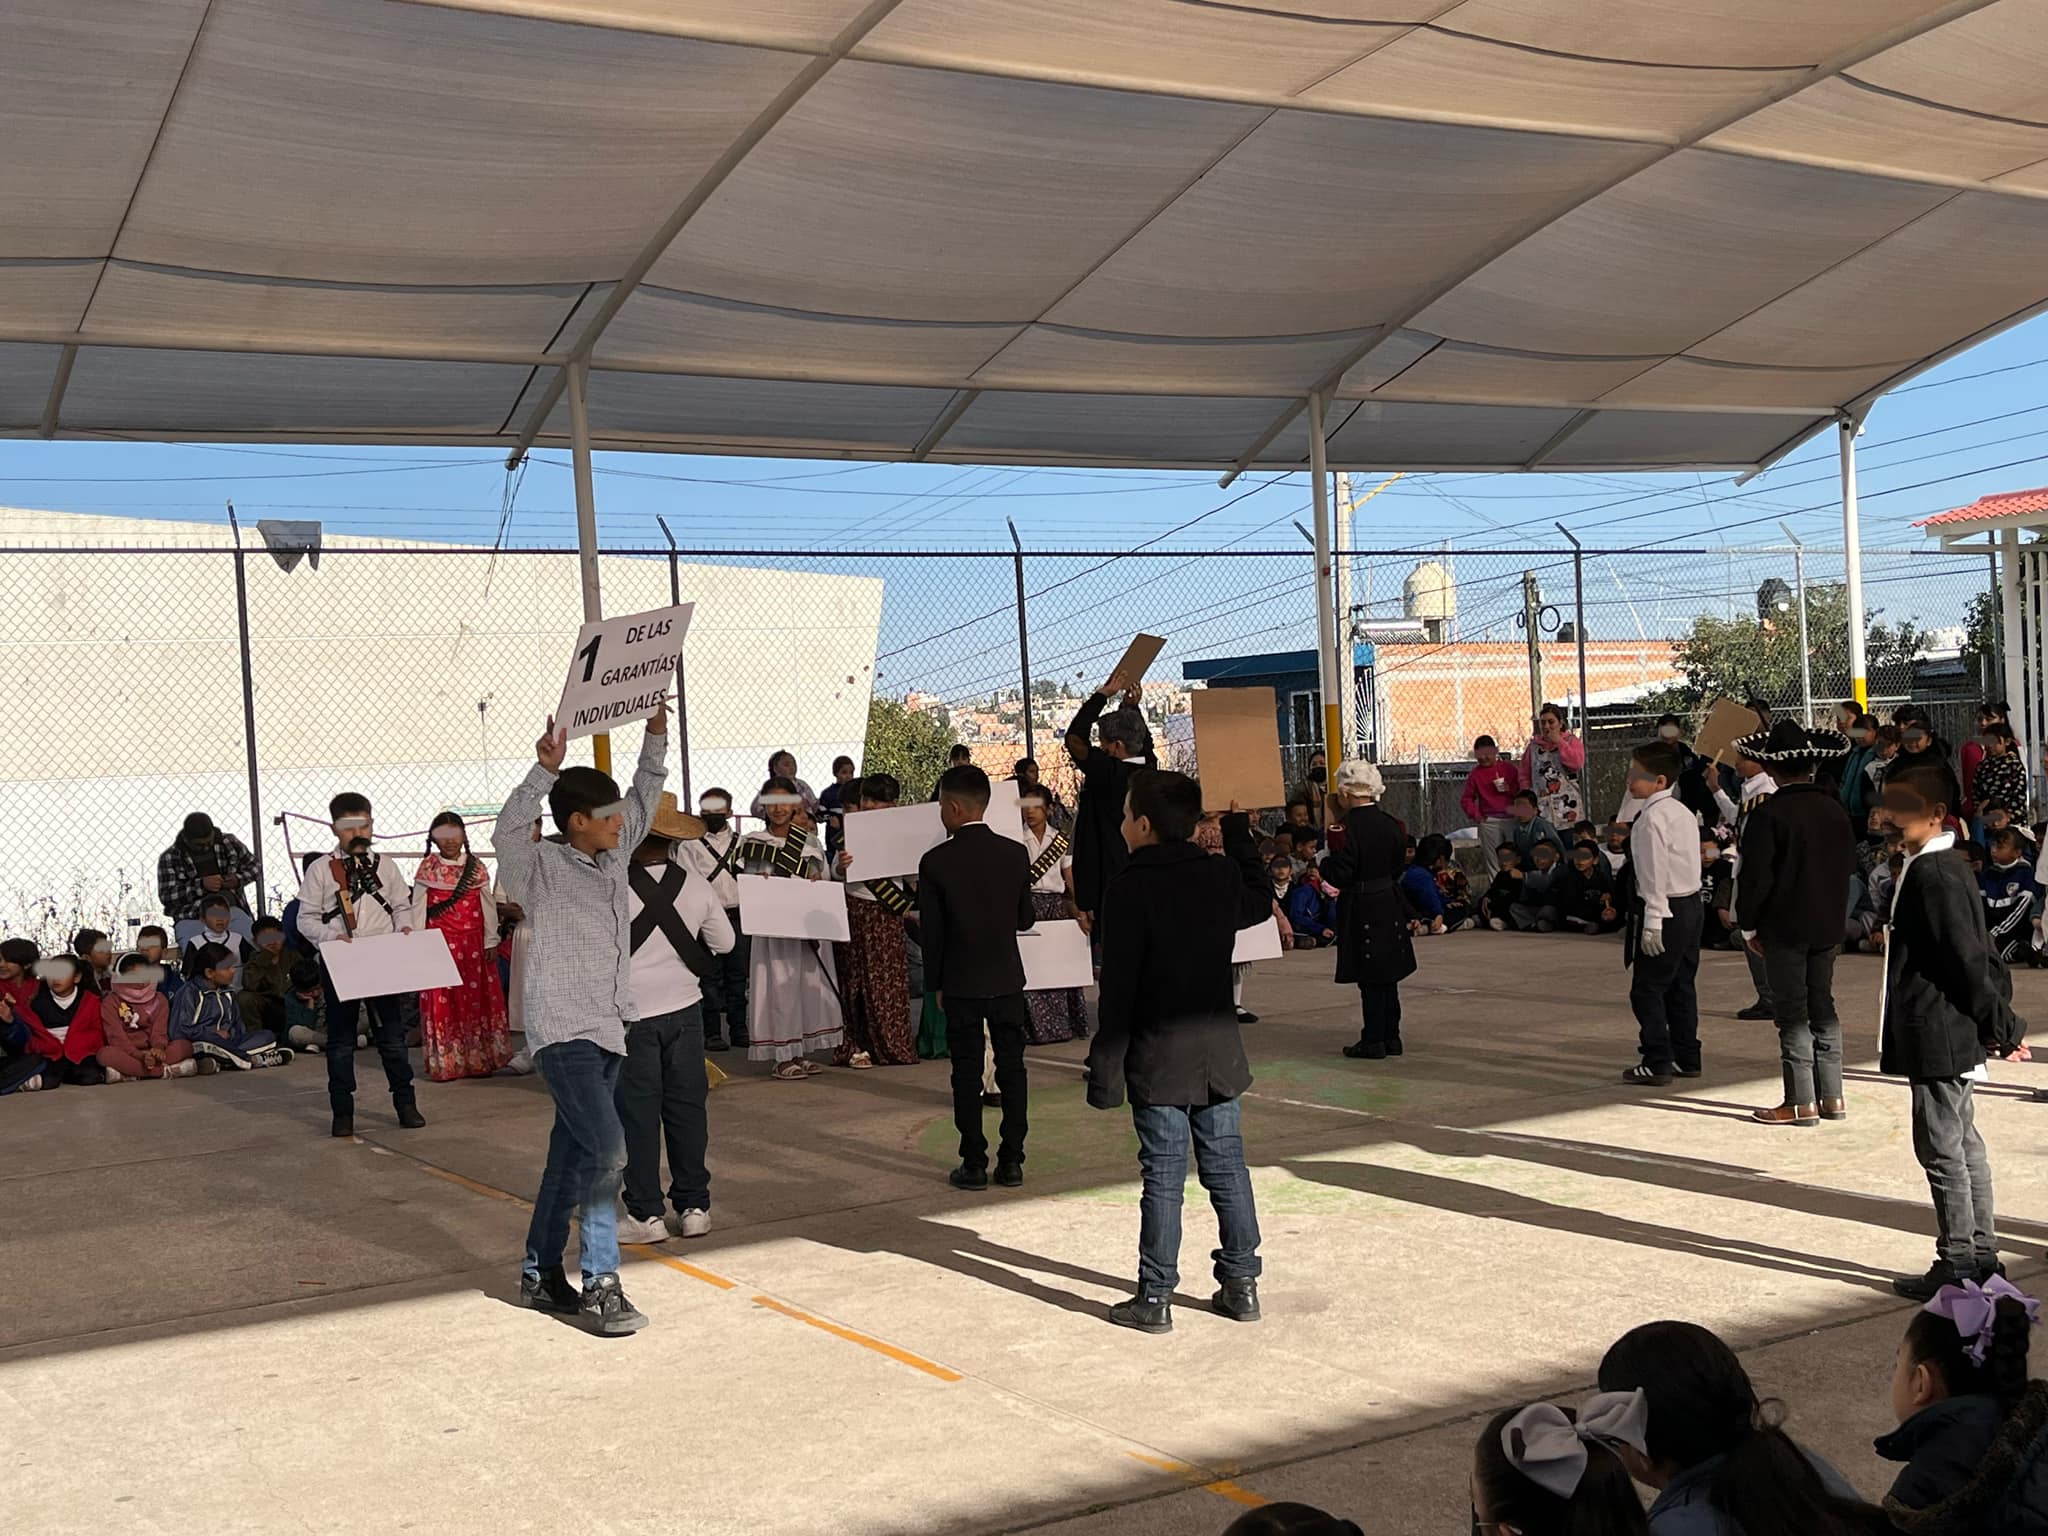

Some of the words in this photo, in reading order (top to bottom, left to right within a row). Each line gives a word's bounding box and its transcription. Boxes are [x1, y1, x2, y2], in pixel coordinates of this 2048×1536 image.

[625, 625, 646, 645] DE
[648, 619, 672, 639] LAS
[578, 634, 602, 683] 1
[601, 653, 677, 686] GARANTÍAS
[573, 688, 667, 728] INDIVIDUALES
